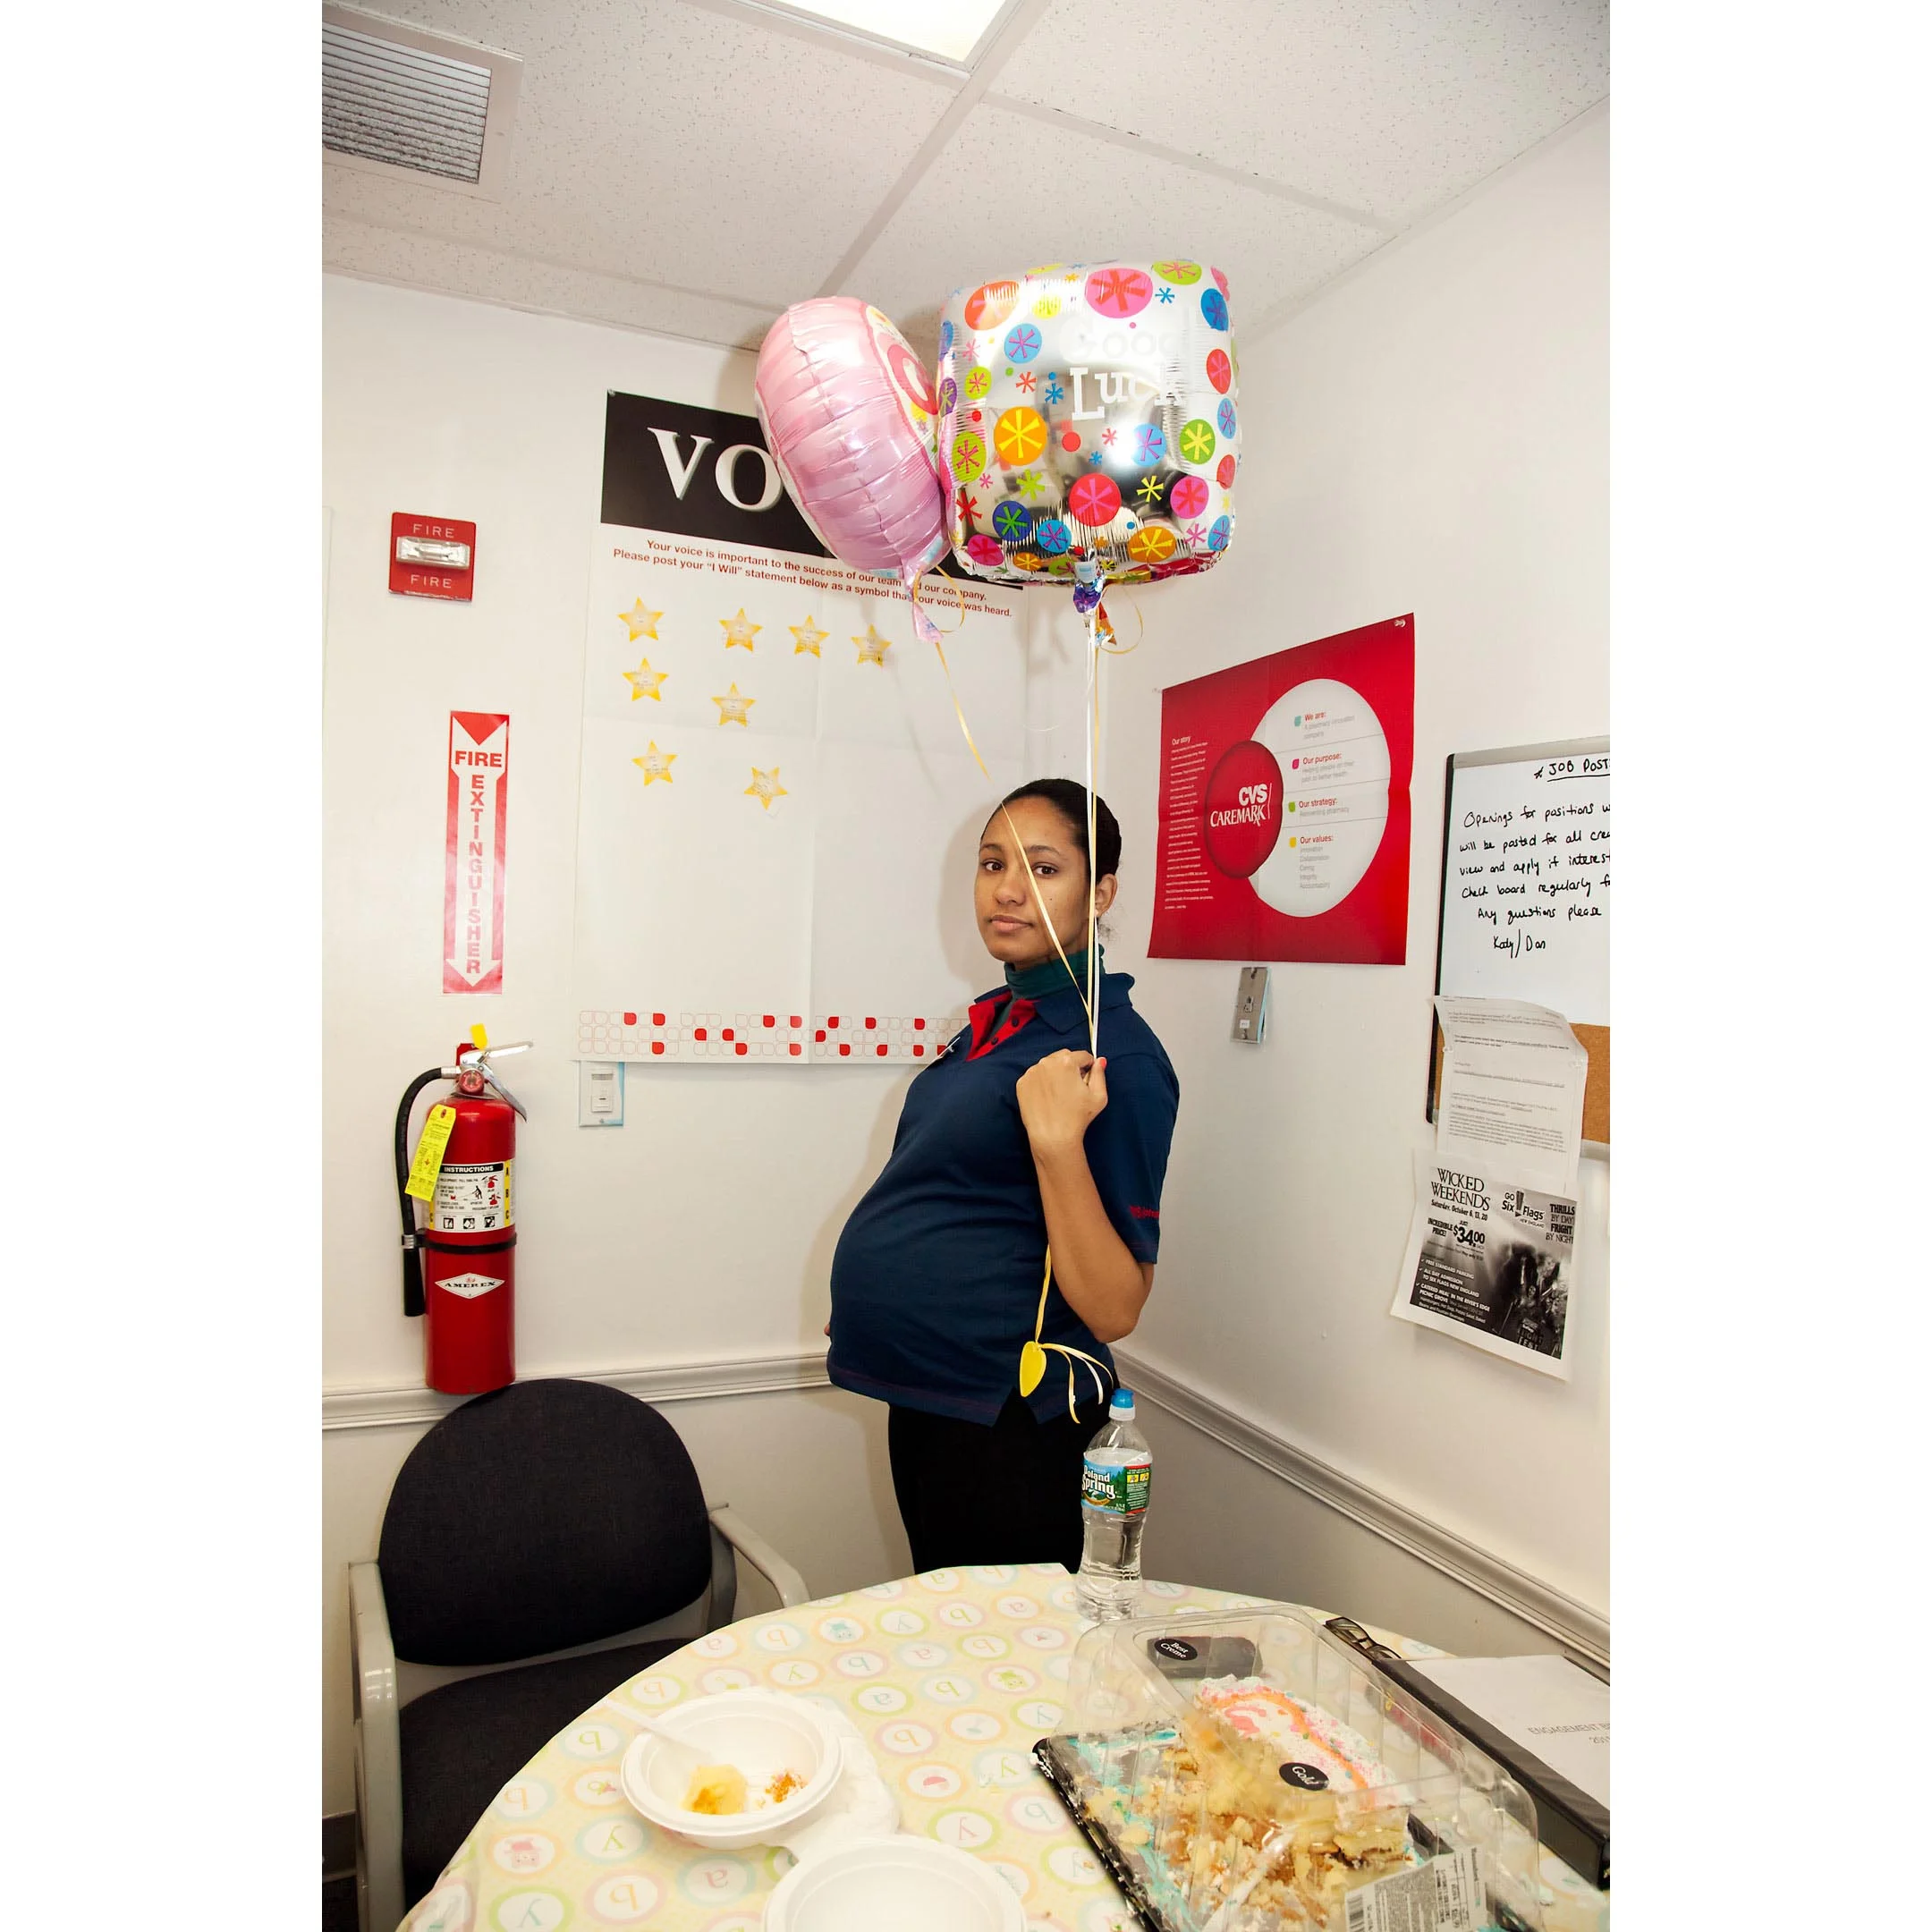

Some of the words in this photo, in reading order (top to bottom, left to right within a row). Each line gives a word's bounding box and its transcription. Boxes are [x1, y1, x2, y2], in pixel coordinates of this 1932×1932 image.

[413, 523, 454, 538] FIRE
[647, 539, 672, 552] Your
[674, 545, 702, 556] voice
[706, 547, 715, 558] is
[717, 550, 768, 567] important
[771, 558, 782, 569] to
[784, 559, 801, 572] the
[803, 565, 843, 579] success
[846, 570, 856, 580] of
[859, 573, 874, 583] our
[877, 577, 902, 587] team
[925, 583, 940, 593] our
[411, 574, 452, 589] FIRE
[613, 548, 650, 563] Please
[653, 555, 677, 566] post
[680, 558, 704, 571] your
[745, 569, 797, 584] statement
[799, 576, 828, 589] below
[832, 581, 843, 591] as
[845, 583, 852, 592] a
[855, 584, 889, 598] symbol
[892, 589, 908, 601] tha
[914, 595, 936, 606] our
[936, 597, 962, 609] voice
[964, 602, 982, 613] was
[985, 605, 1012, 617] heard.
[1304, 714, 1314, 722] We
[455, 750, 503, 767] FIRE
[1315, 753, 1342, 764] purpose:
[1548, 760, 1574, 775] JOB
[1239, 783, 1267, 806] CVS
[1310, 798, 1337, 808] strategy:
[1210, 804, 1267, 827] CAREMARK
[1464, 811, 1513, 828] Openings
[1521, 806, 1536, 819] for
[1545, 803, 1594, 822] positions
[1312, 835, 1334, 843] values:
[1460, 841, 1477, 852] will
[1483, 840, 1495, 850] be
[1503, 834, 1537, 853] posted
[1542, 833, 1557, 844] for
[1565, 830, 1581, 843] all
[466, 774, 485, 974] EXTINGUISHER
[1460, 865, 1483, 877] view
[1490, 861, 1505, 873] and
[1513, 859, 1539, 877] apply
[1497, 884, 1526, 894] board
[1538, 877, 1591, 897] regularly
[1478, 908, 1496, 925] Any
[1507, 905, 1556, 925] questions
[1568, 904, 1602, 921] please
[445, 1165, 494, 1174] INSTRUCTIONS
[1437, 1167, 1485, 1192] WICKED
[1431, 1182, 1491, 1211] WEEKENDS
[1452, 1205, 1469, 1216] October
[1481, 1213, 1488, 1221] 20
[1502, 1200, 1515, 1212] Six
[1523, 1206, 1545, 1221] Flags
[1550, 1204, 1575, 1216] THRILLS
[1428, 1217, 1453, 1231] INCREDIBLE
[1551, 1214, 1560, 1222] BY
[1550, 1223, 1572, 1234] FRIGHT
[1546, 1233, 1555, 1241] BY
[1456, 1269, 1474, 1279] PARKING
[1084, 1465, 1110, 1483] Poland
[1082, 1474, 1116, 1500] Spring
[1160, 1642, 1187, 1658] Creme
[1171, 1642, 1189, 1654] Best
[1528, 1723, 1597, 1734] ENGAGEMENT
[1292, 1767, 1319, 1785] Gold
